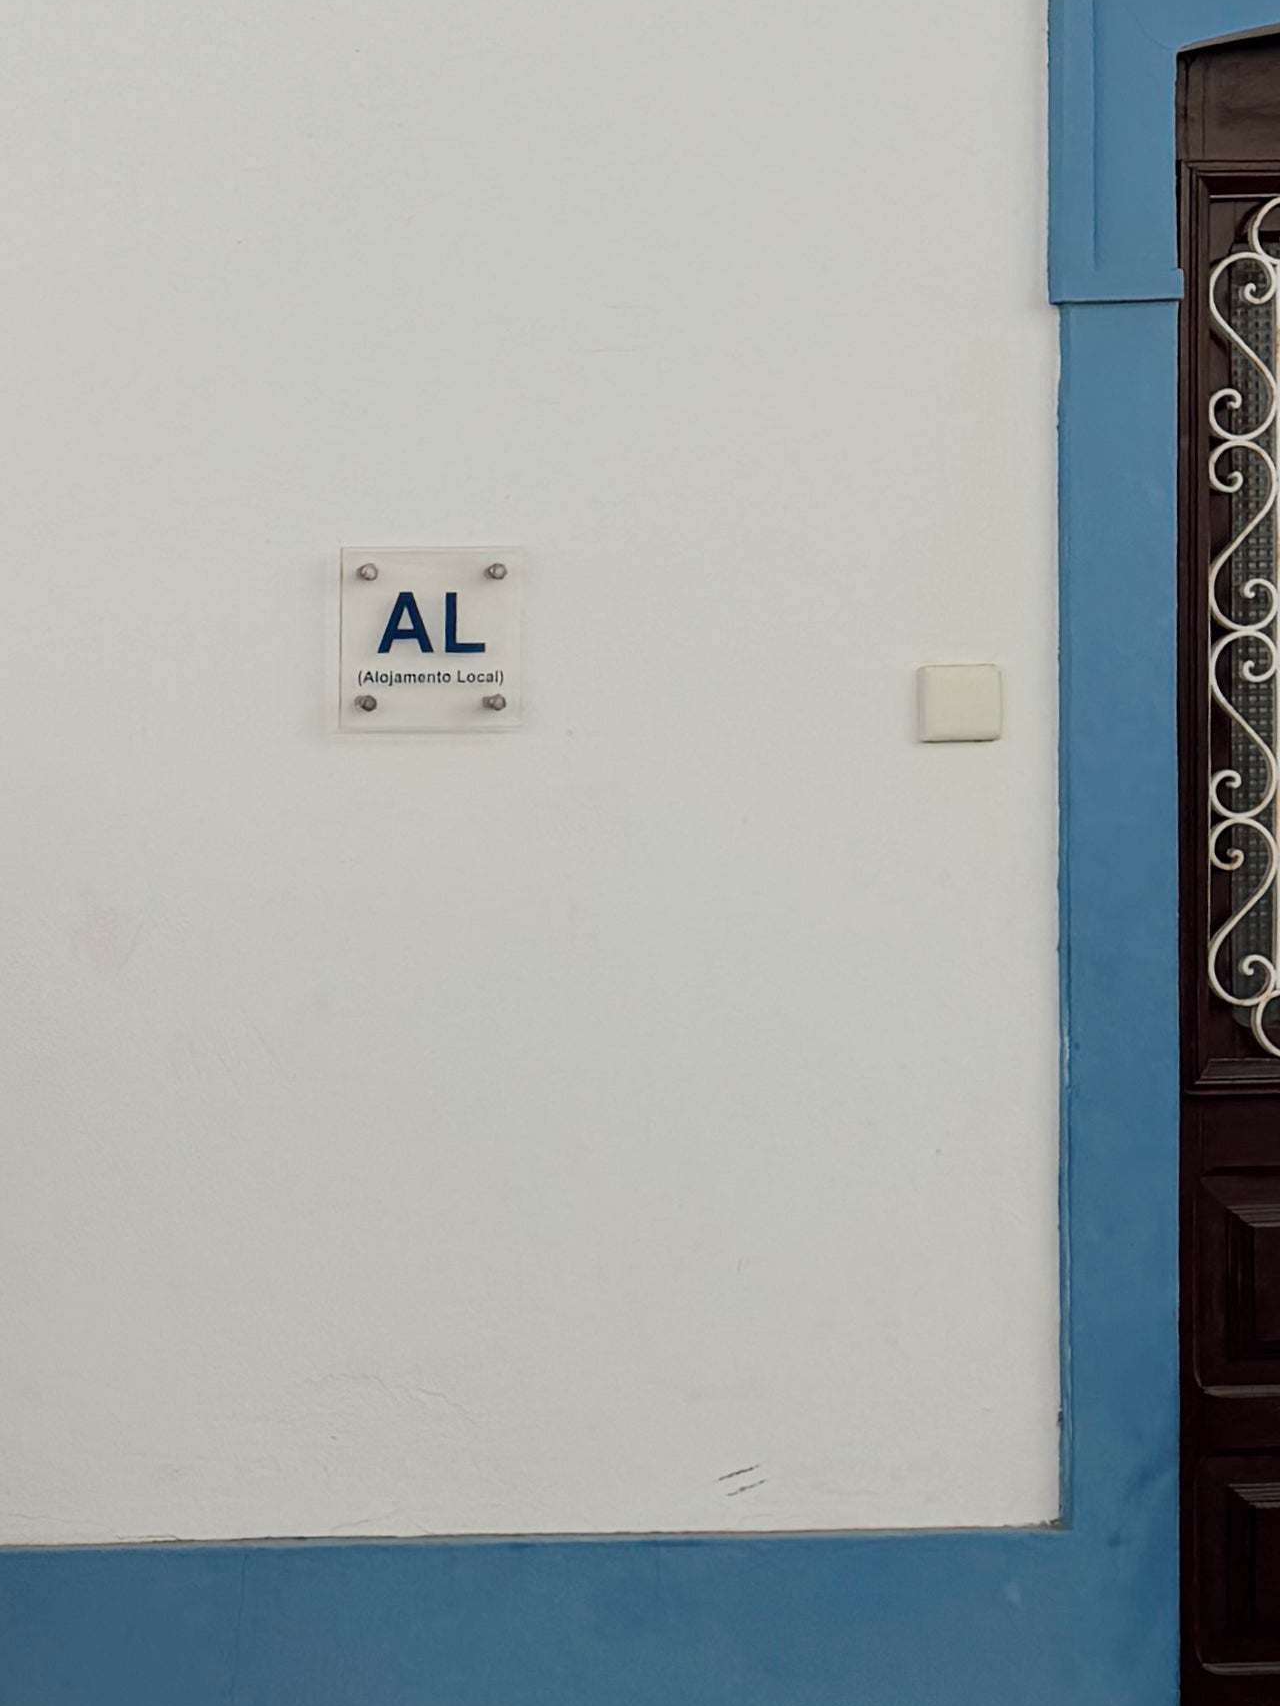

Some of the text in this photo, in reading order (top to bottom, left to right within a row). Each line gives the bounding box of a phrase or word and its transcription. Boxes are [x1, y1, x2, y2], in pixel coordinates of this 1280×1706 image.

[377, 591, 486, 653] AL
[358, 669, 504, 687] (Alojamento Local)
